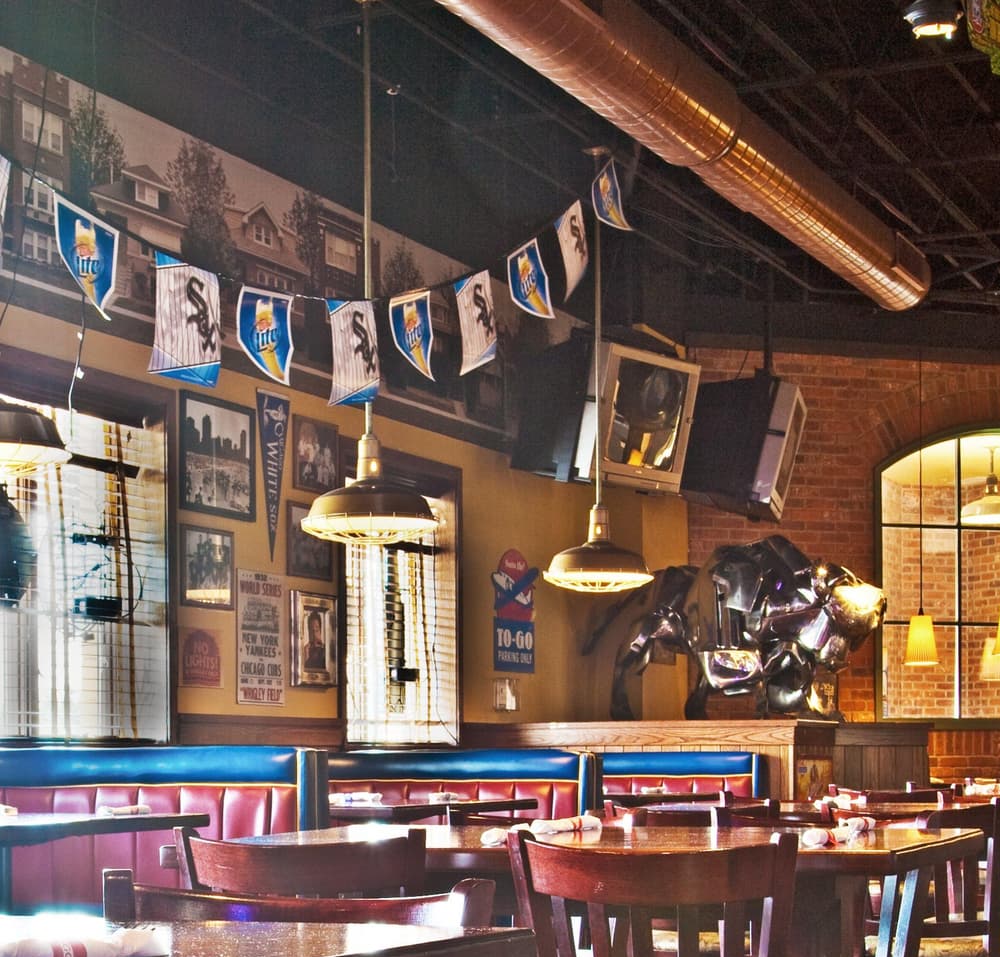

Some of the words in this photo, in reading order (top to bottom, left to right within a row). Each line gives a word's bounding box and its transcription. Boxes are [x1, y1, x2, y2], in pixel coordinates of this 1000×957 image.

[266, 441, 279, 500] WHITE
[269, 504, 278, 532] SOX
[240, 580, 260, 595] WORLD
[262, 581, 282, 598] SERIES
[242, 632, 257, 644] NEW
[260, 633, 279, 647] YORK
[497, 628, 533, 650] TO-GO
[194, 641, 209, 656] NO
[245, 646, 277, 658] YANKEES
[497, 650, 520, 663] PARKING
[520, 652, 533, 665] ONLY
[240, 662, 265, 676] CHICAGO
[267, 663, 282, 677] CUBS
